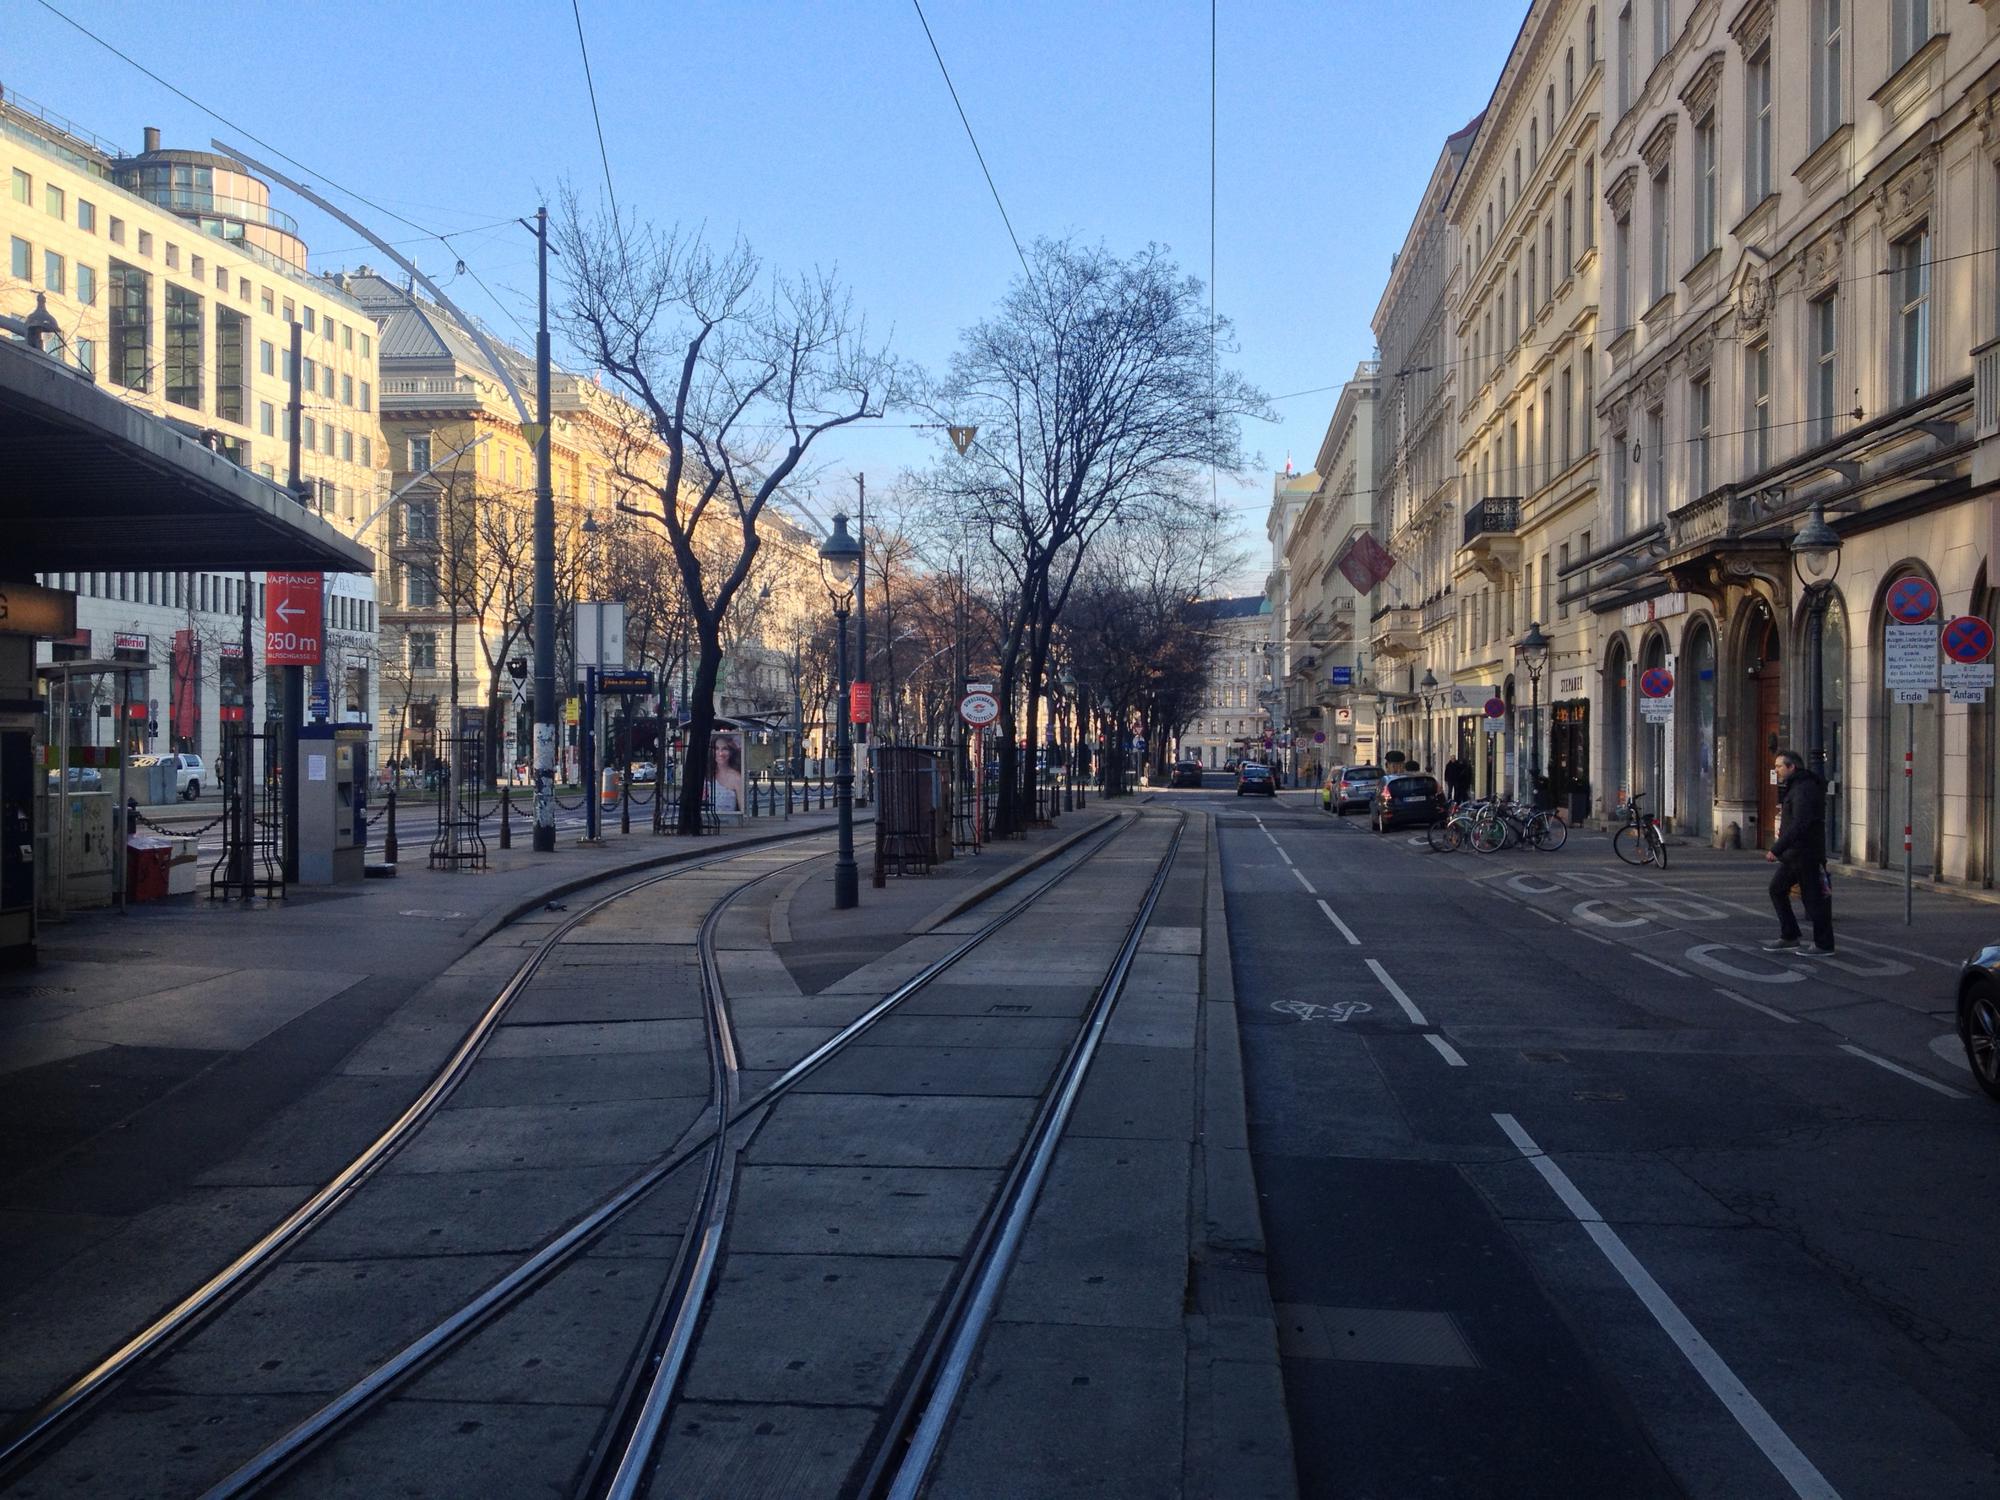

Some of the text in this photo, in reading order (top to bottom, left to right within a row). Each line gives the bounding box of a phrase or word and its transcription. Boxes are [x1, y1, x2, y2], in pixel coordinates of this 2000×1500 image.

[267, 574, 316, 585] VAPIANO
[267, 632, 296, 650] 250
[300, 637, 317, 651] m
[1900, 691, 1922, 701] Ende
[1953, 690, 1981, 700] Anfang
